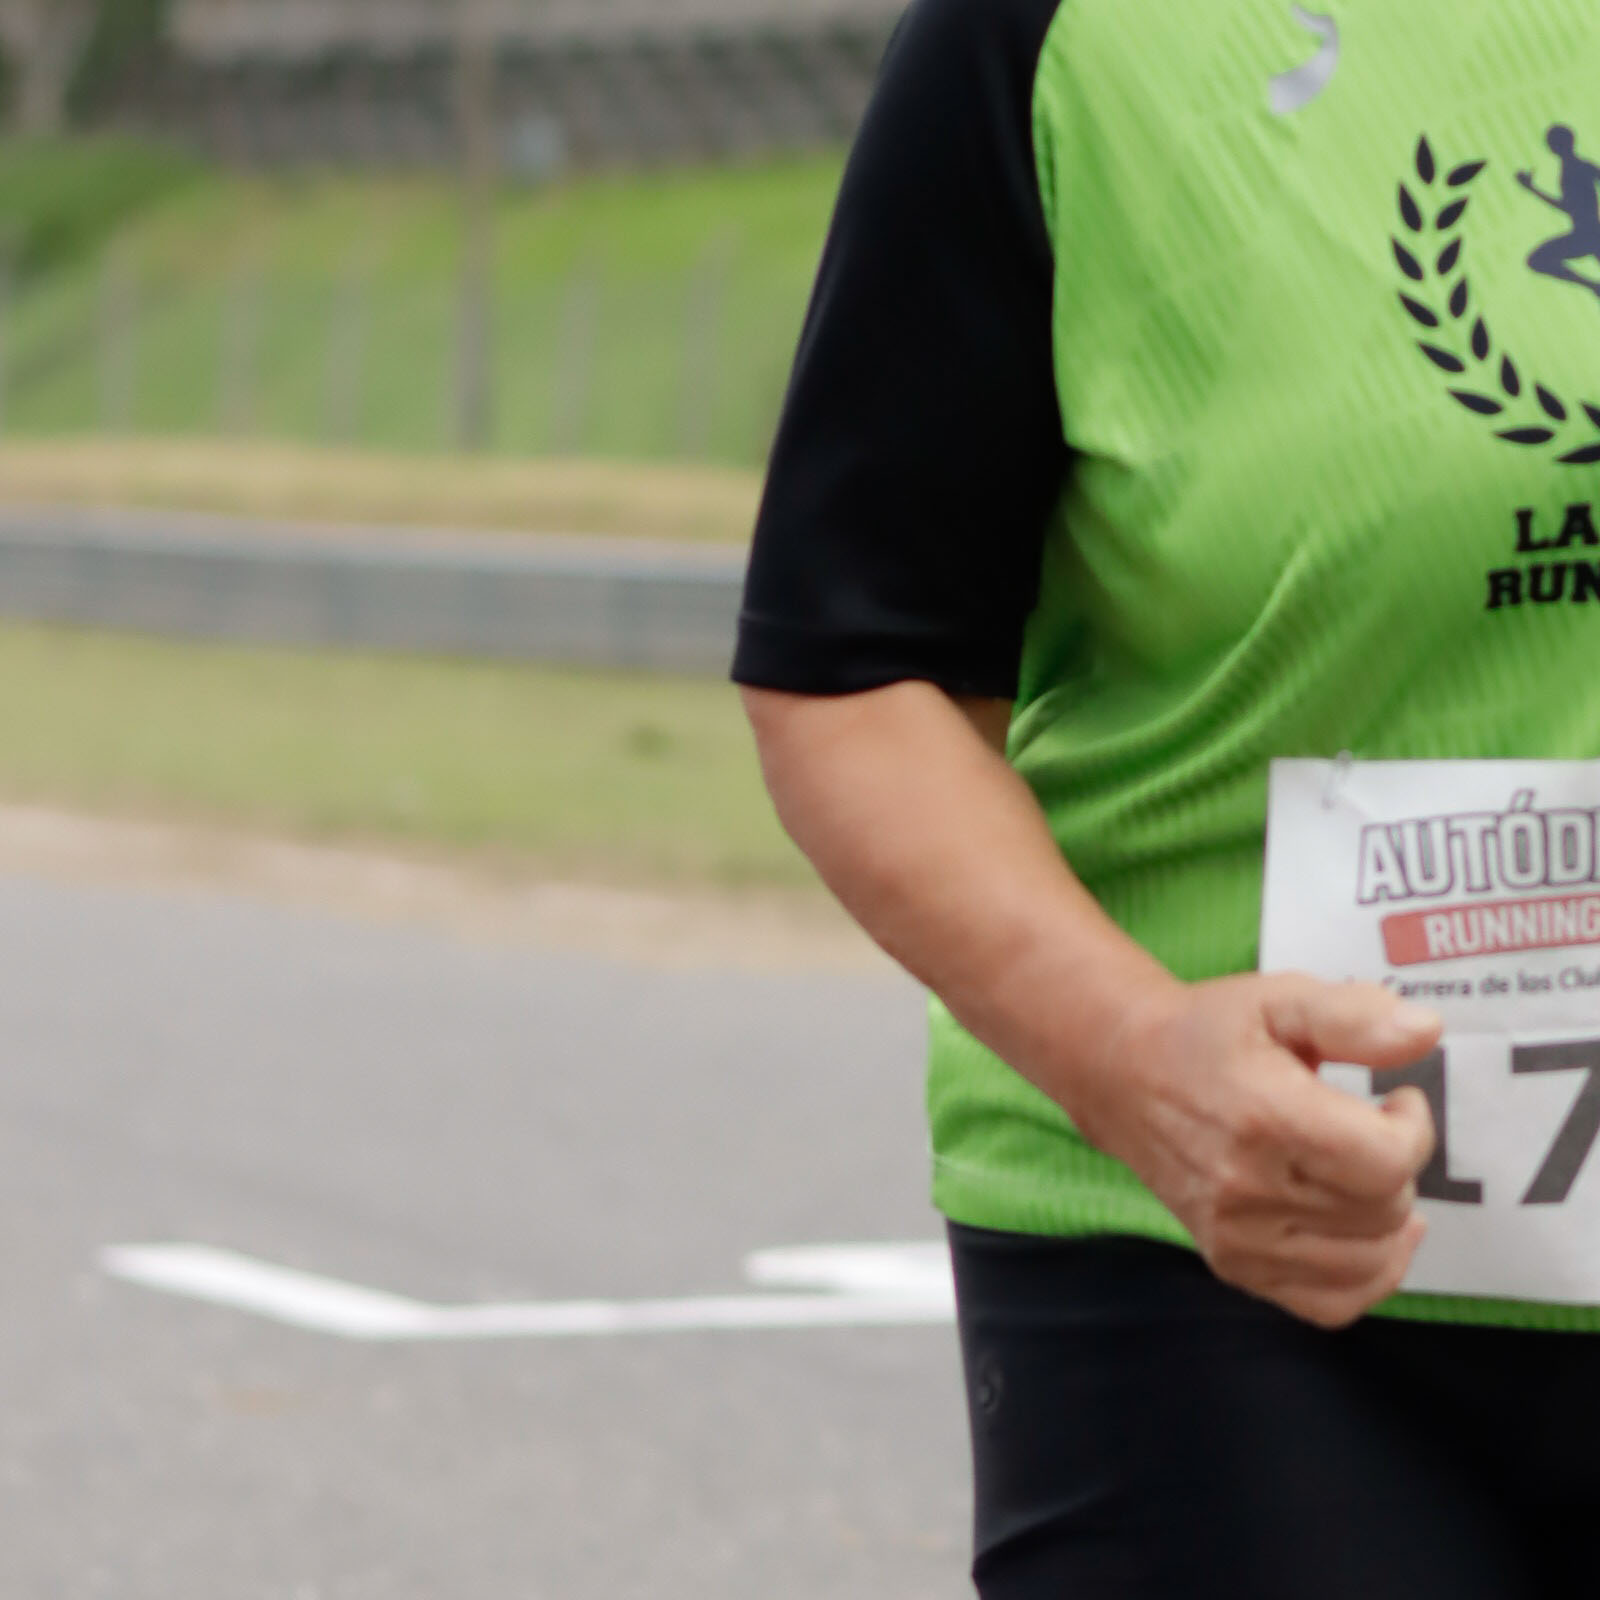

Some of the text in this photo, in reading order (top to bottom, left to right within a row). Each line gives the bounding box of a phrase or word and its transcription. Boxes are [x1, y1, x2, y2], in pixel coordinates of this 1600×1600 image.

[1514, 503, 1600, 552] LA
[1479, 973, 1509, 996] de
[1517, 969, 1552, 993] los
